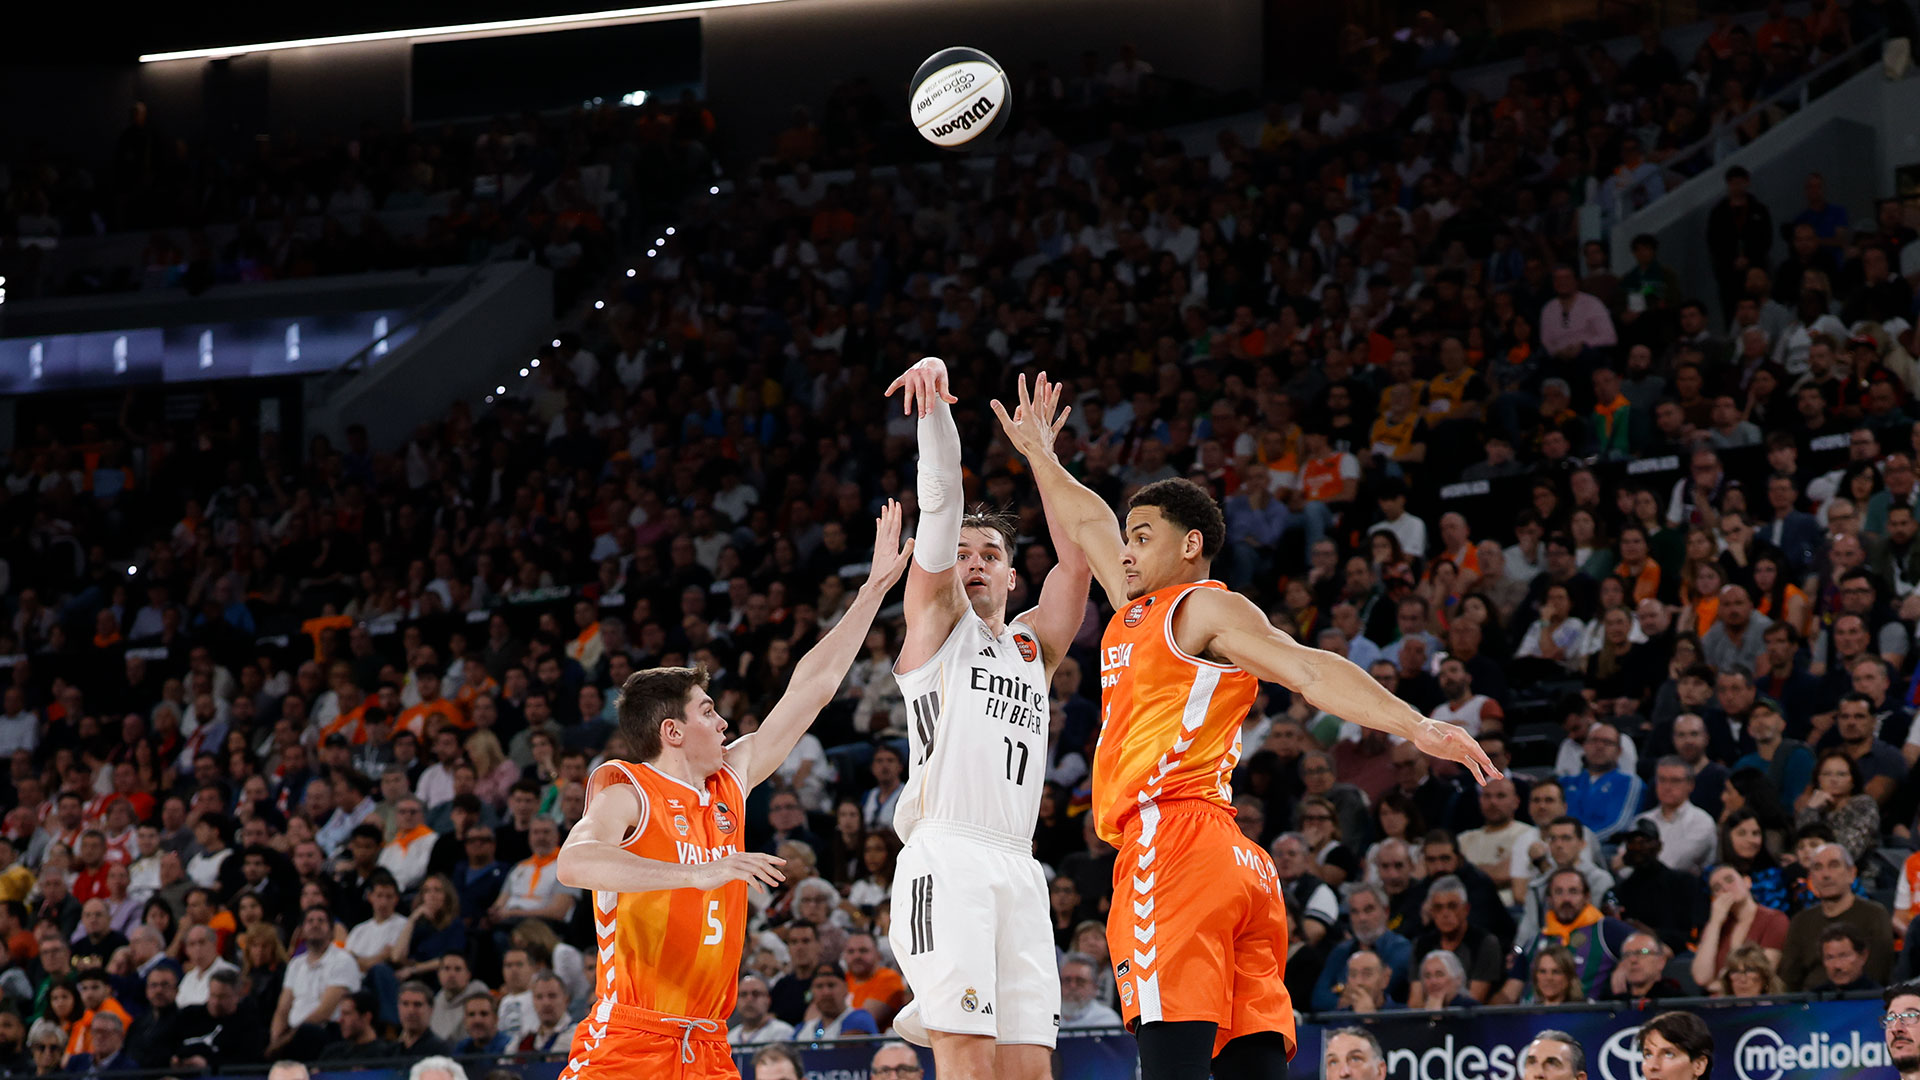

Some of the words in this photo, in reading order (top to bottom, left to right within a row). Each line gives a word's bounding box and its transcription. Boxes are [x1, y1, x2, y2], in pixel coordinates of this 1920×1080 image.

[943, 73, 975, 92] Copa
[954, 82, 972, 94] acb
[917, 98, 932, 114] Rey
[931, 96, 995, 138] Wilson
[986, 697, 1008, 721] FLY
[703, 900, 724, 946] 5
[1387, 1034, 1532, 1080] ndes
[1744, 1031, 1892, 1072] mediola
